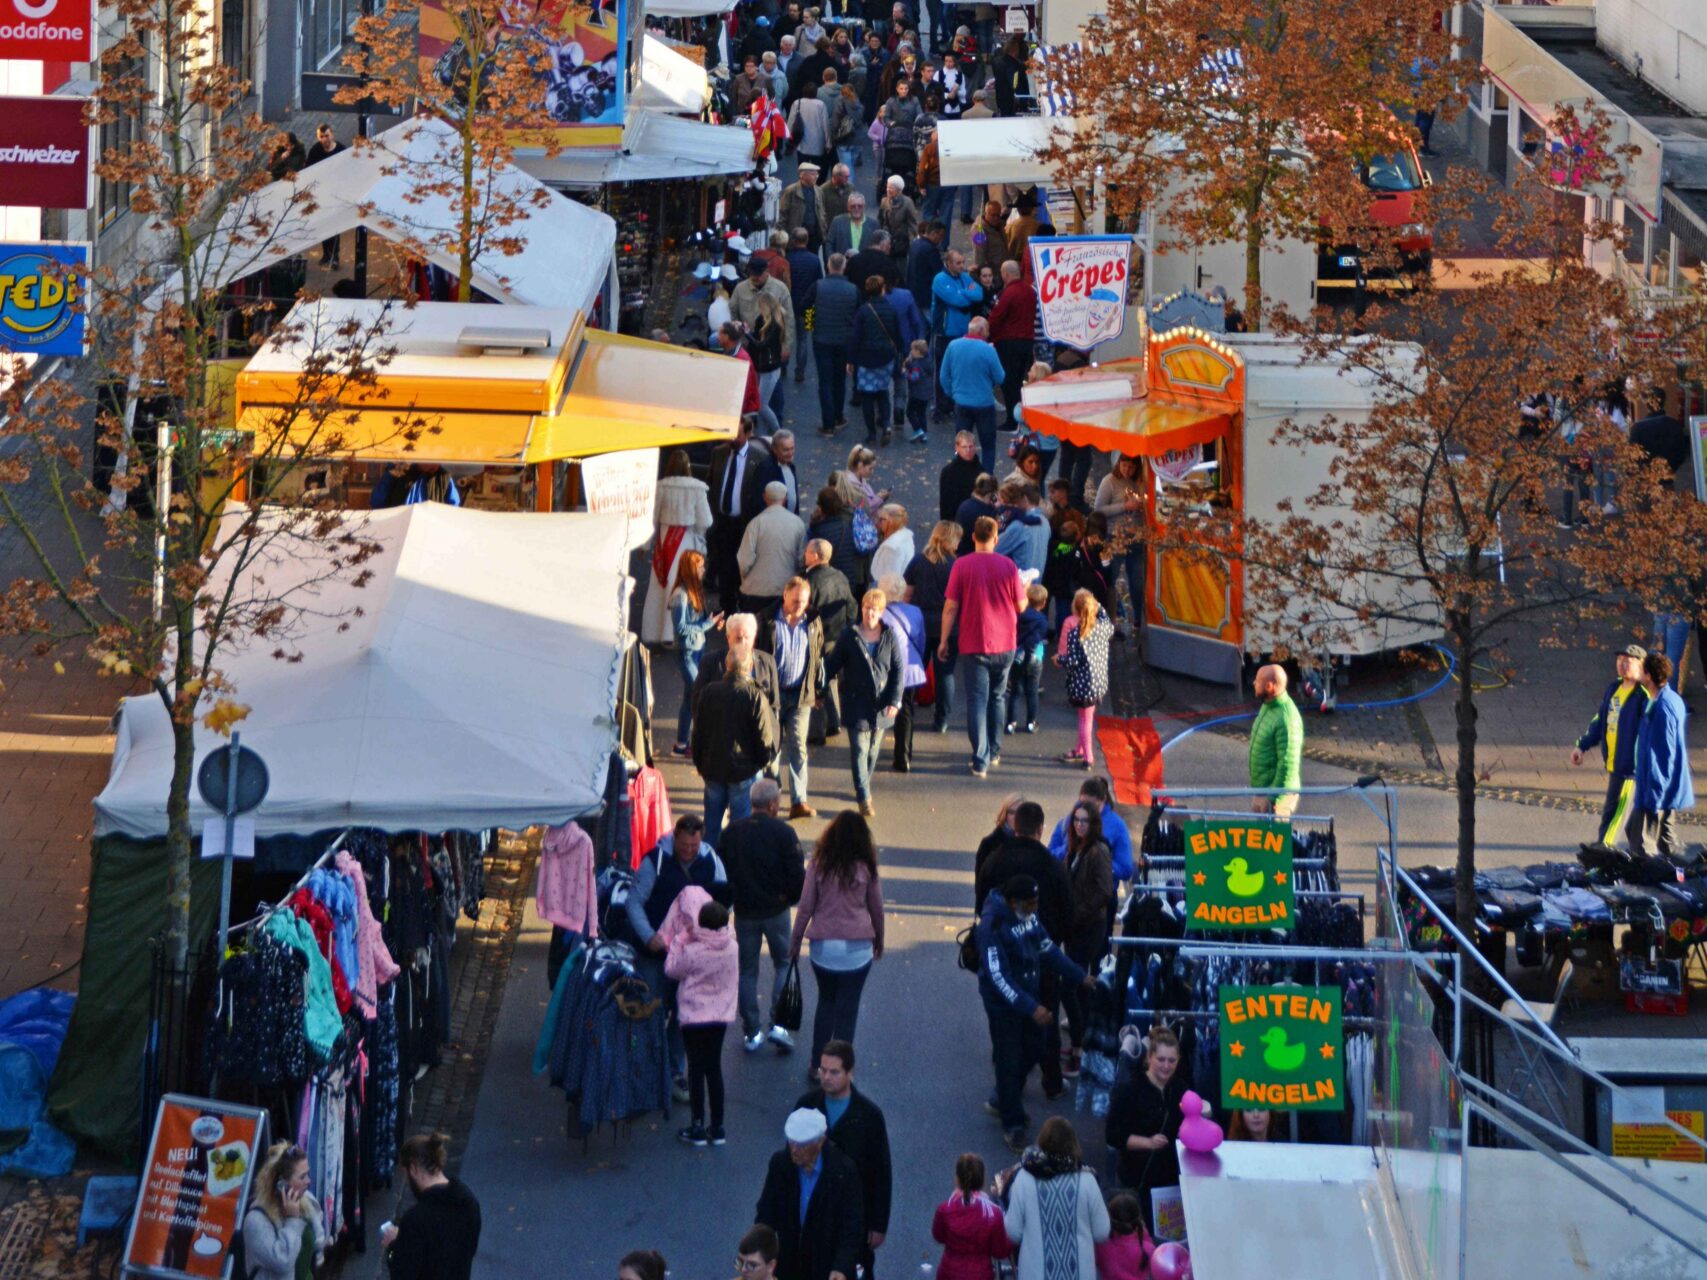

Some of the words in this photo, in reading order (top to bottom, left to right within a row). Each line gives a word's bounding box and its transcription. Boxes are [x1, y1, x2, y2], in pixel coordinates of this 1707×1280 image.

[0, 22, 83, 40] odafone
[1041, 258, 1126, 304] Crêpes
[1190, 828, 1284, 855] ENTEN
[1194, 900, 1287, 924] ANGELN
[1225, 994, 1331, 1024] ENTEN
[1229, 1078, 1335, 1104] ANGELN
[168, 1147, 198, 1161] NEU!
[160, 1194, 208, 1215] Blattspinat
[159, 1210, 223, 1234] Kartoffelpüree
